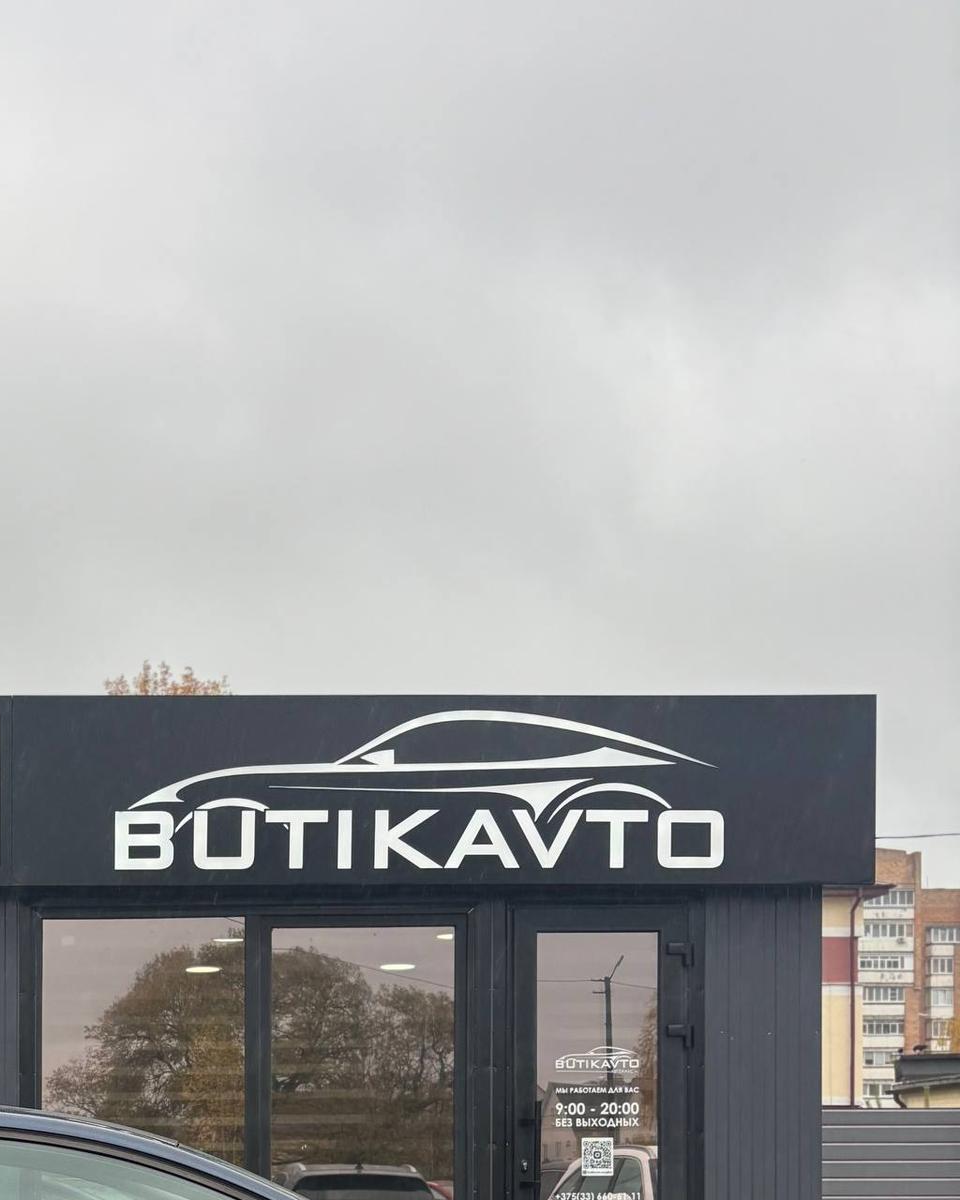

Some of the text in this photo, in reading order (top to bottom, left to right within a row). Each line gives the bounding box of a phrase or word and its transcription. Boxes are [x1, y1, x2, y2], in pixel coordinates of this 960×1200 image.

[114, 808, 725, 870] BUTIKAVTO
[555, 1059, 640, 1069] BUTIKAVTO
[555, 1086, 640, 1094] МЫ РАБОТАЕМ ДЛЯ ВАС
[555, 1102, 586, 1115] 9:00
[600, 1102, 640, 1115] 20:00
[555, 1118, 640, 1128] БЕЗ ВЫХОДНЫХ
